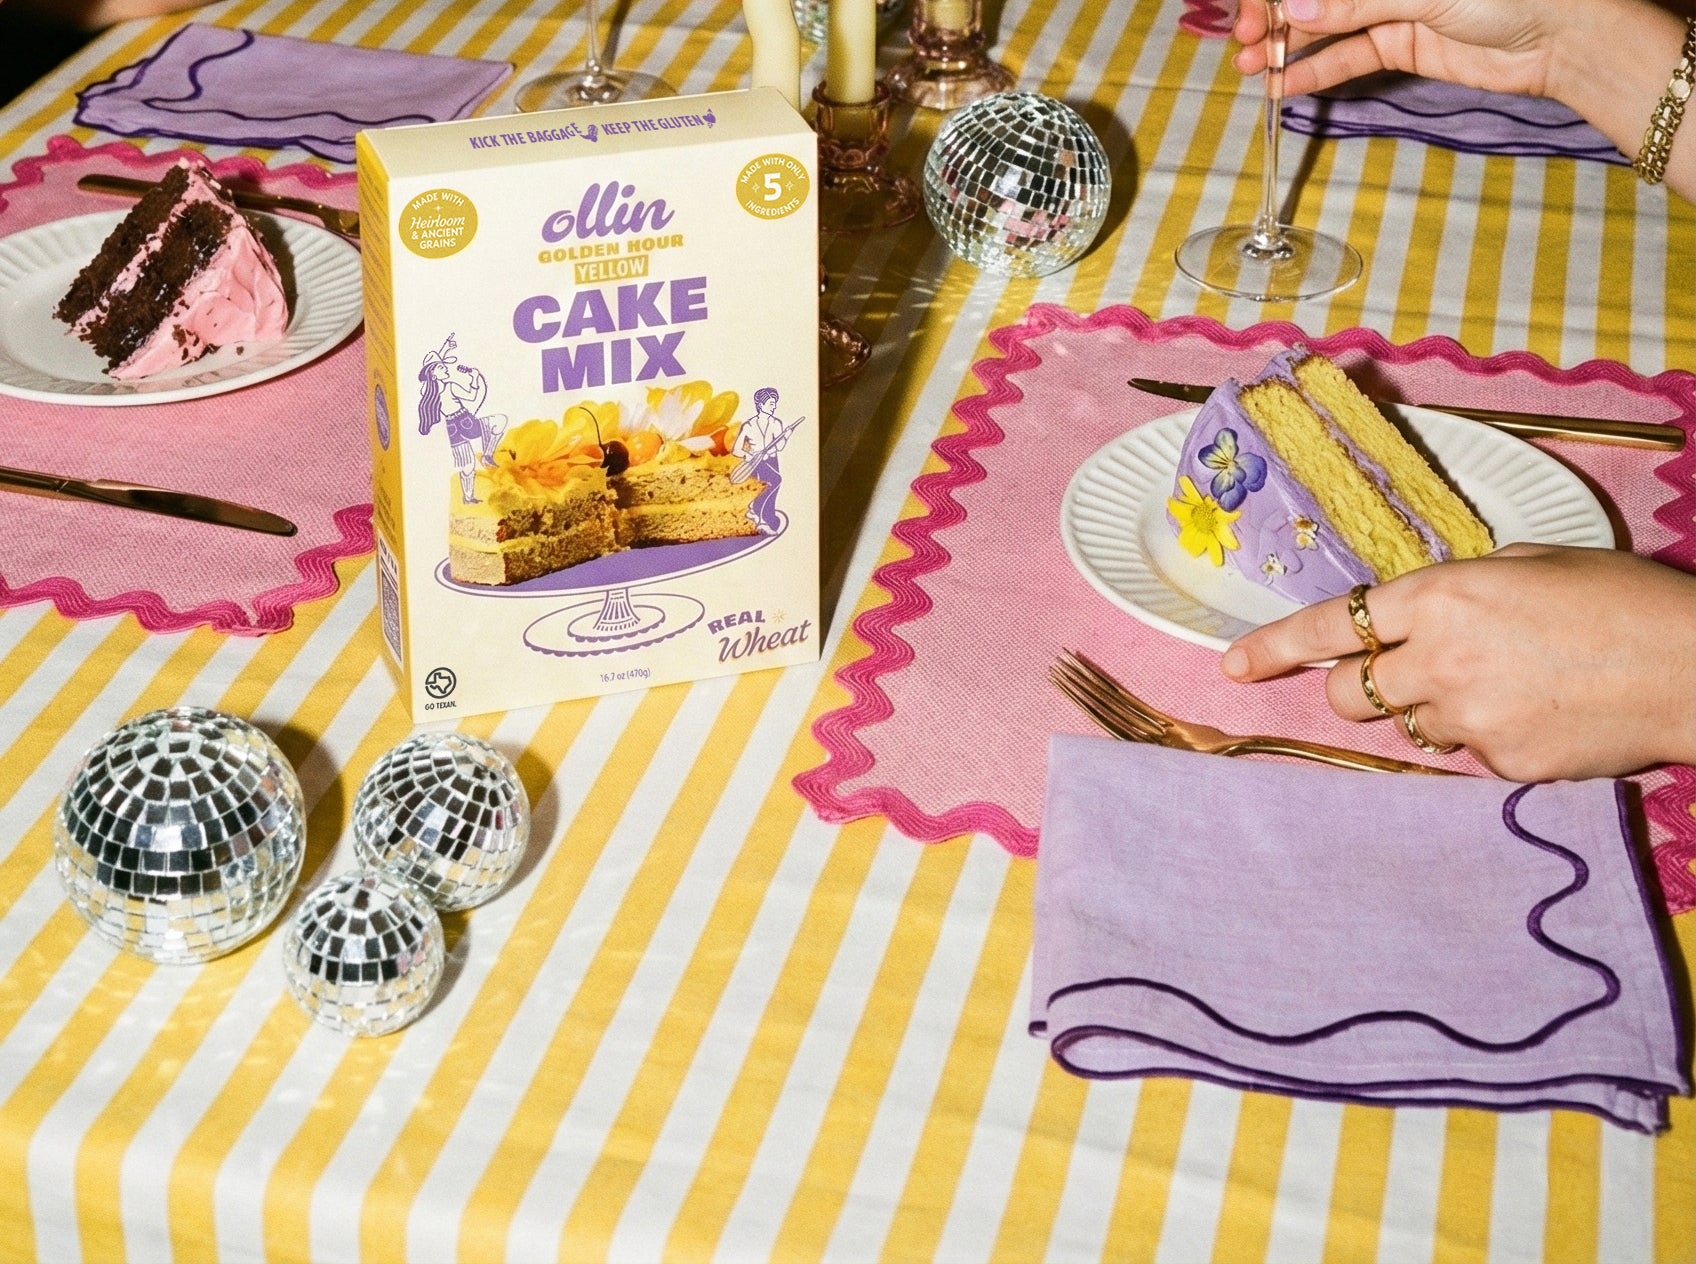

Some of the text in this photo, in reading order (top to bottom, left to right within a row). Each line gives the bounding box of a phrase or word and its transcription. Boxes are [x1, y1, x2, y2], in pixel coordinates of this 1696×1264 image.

[469, 114, 705, 149] KICK THE BAGGAGE KEEP THE GLUTEN
[740, 157, 806, 184] MADE WITH ONLY
[763, 172, 782, 201] 5
[411, 192, 465, 210] MADE WITH
[541, 180, 675, 243] ollin
[745, 197, 800, 216] INGREDIENTS
[409, 214, 465, 230] Heirloom
[411, 227, 465, 240] & ANCIENT
[419, 238, 456, 250] GRAINS
[538, 234, 684, 264] GOLDEN HOUR
[577, 256, 646, 282] YELLOW
[513, 276, 708, 344] CAKE
[541, 330, 687, 394] MIX
[707, 610, 766, 635] REAL
[718, 619, 812, 662] Wheat
[616, 672, 625, 681] oz
[626, 667, 651, 680] (470g)
[424, 702, 434, 711] GO
